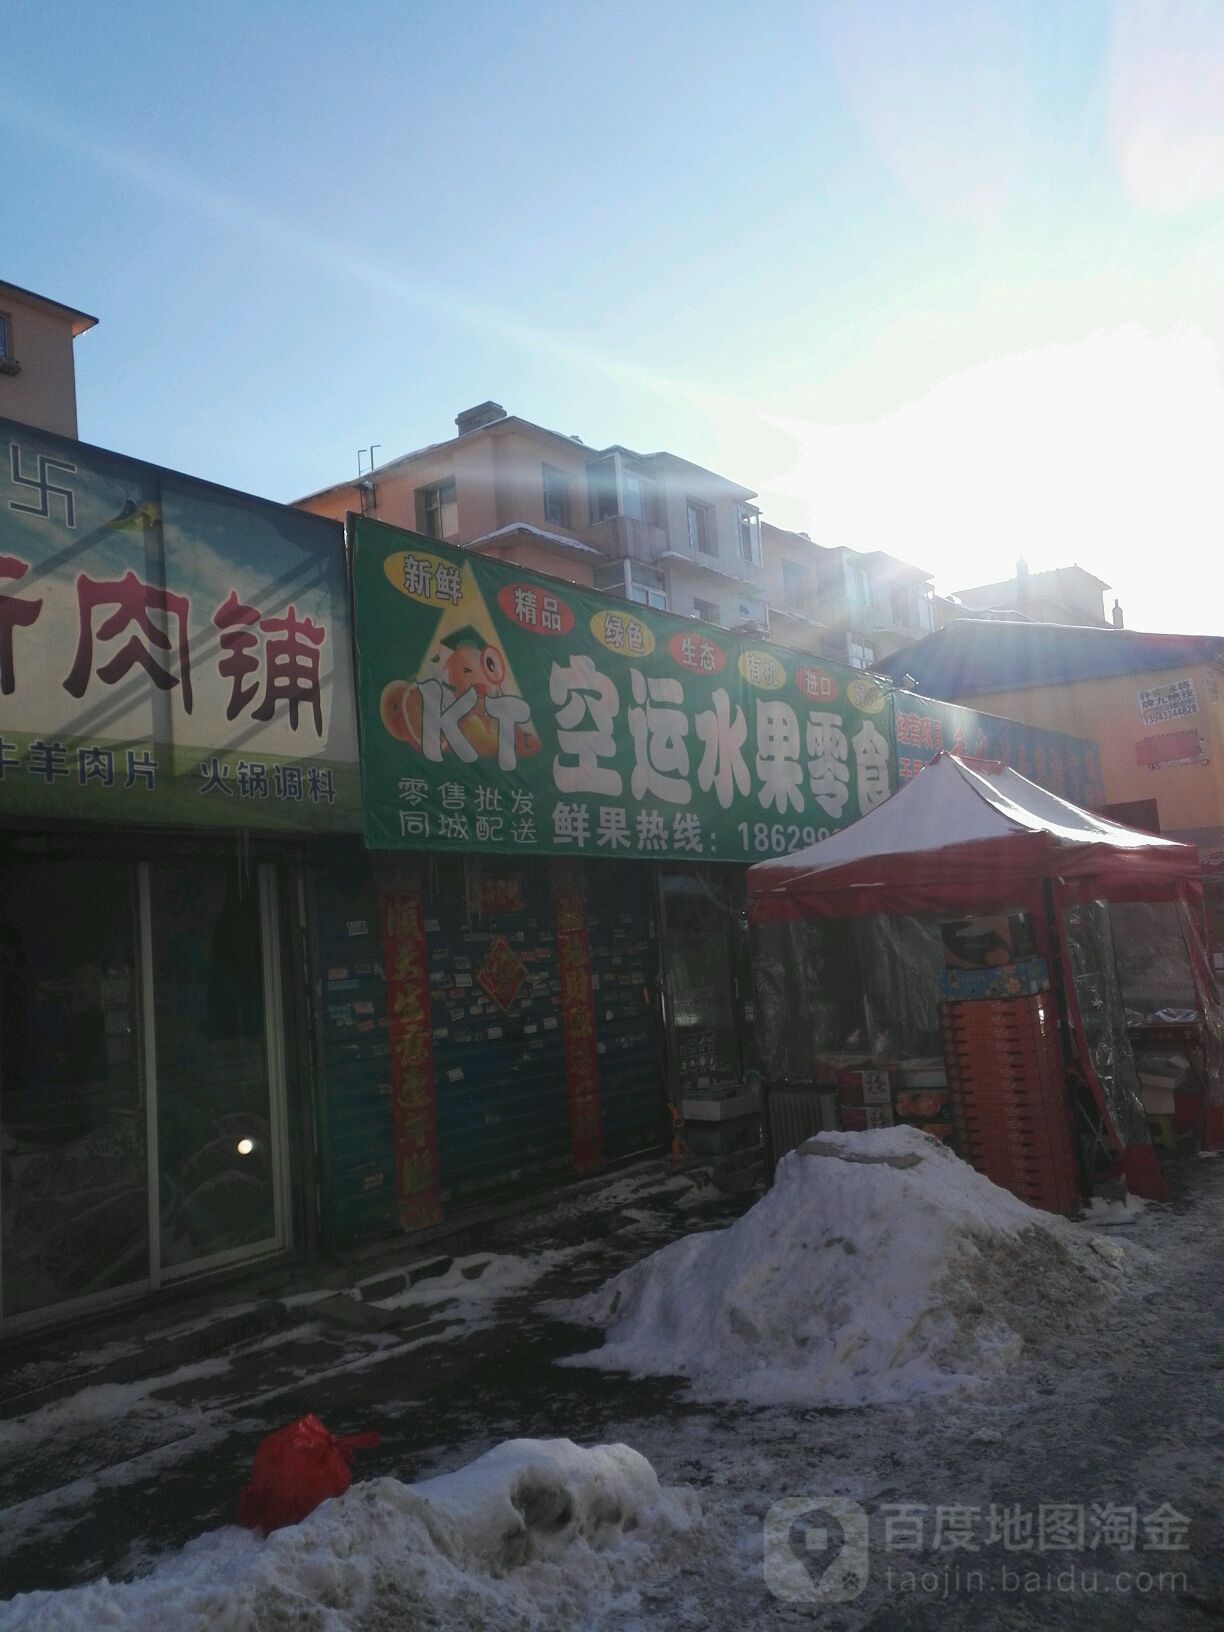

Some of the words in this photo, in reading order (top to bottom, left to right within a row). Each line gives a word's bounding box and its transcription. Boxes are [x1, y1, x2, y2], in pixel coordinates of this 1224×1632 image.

[403, 554, 463, 606] 新鲜
[514, 586, 562, 632] 精品
[603, 613, 647, 655] 绿色
[680, 634, 716, 672] 生态
[746, 651, 778, 686] 有机
[416, 679, 531, 772] KT
[549, 654, 892, 819] 空运水果零食
[200, 758, 336, 804] 火锅调料
[398, 777, 535, 815] 零售批发
[399, 809, 538, 844] 同城配送
